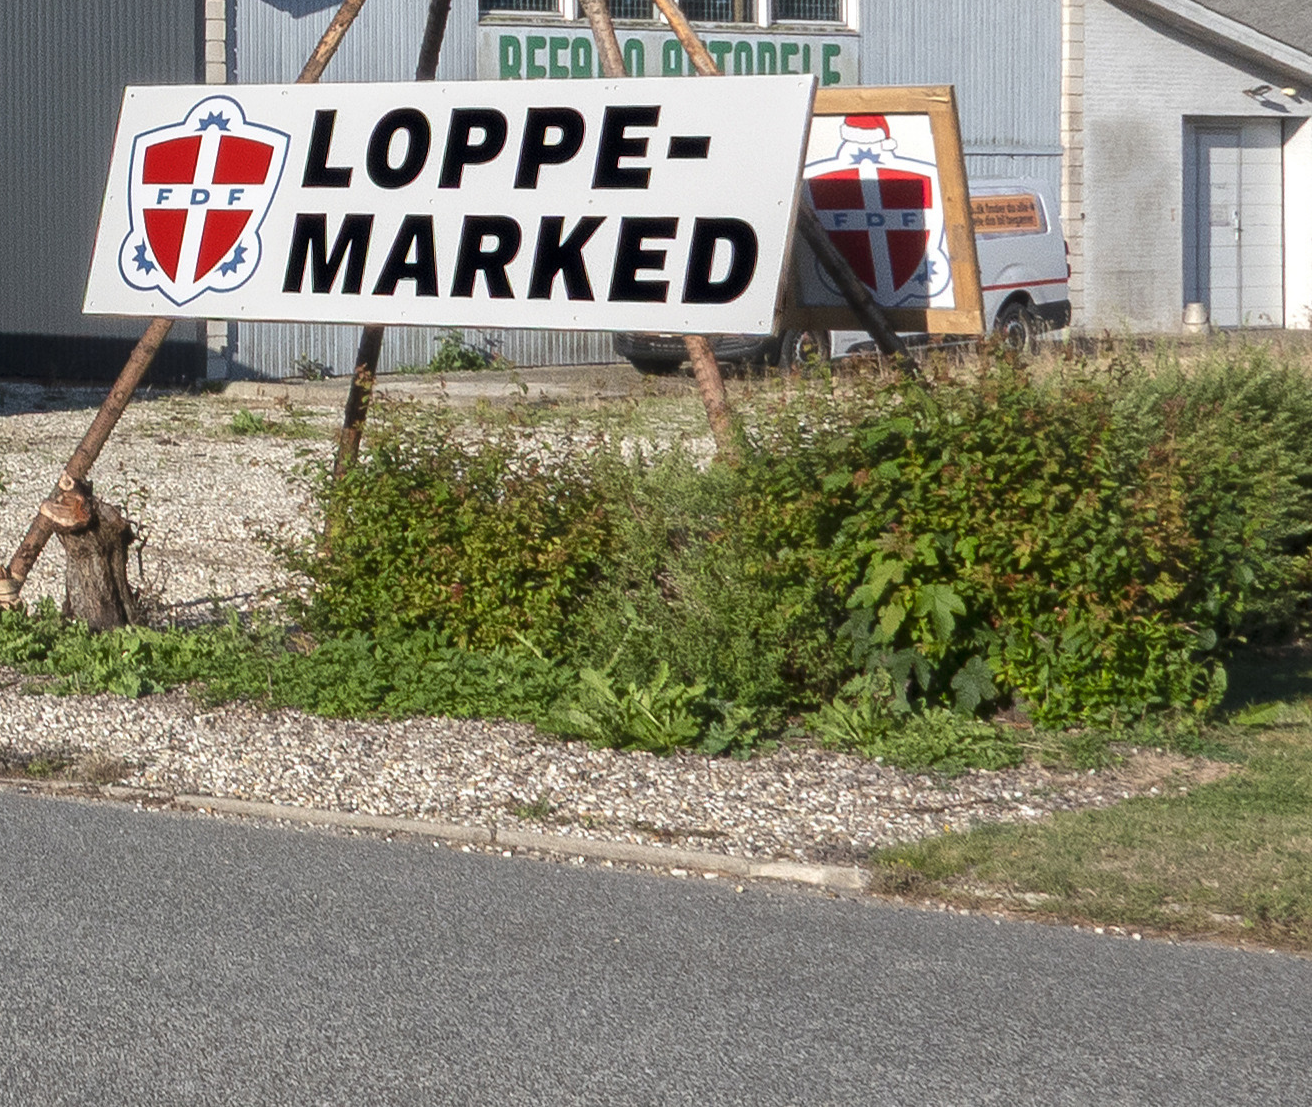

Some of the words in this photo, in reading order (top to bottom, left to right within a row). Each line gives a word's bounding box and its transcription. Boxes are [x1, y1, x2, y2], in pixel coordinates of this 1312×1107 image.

[662, 39, 841, 86] ATODELE
[301, 105, 711, 190] LOPPE-
[156, 188, 245, 206] FDF
[833, 212, 917, 228] FDF
[282, 212, 759, 304] MARKED
